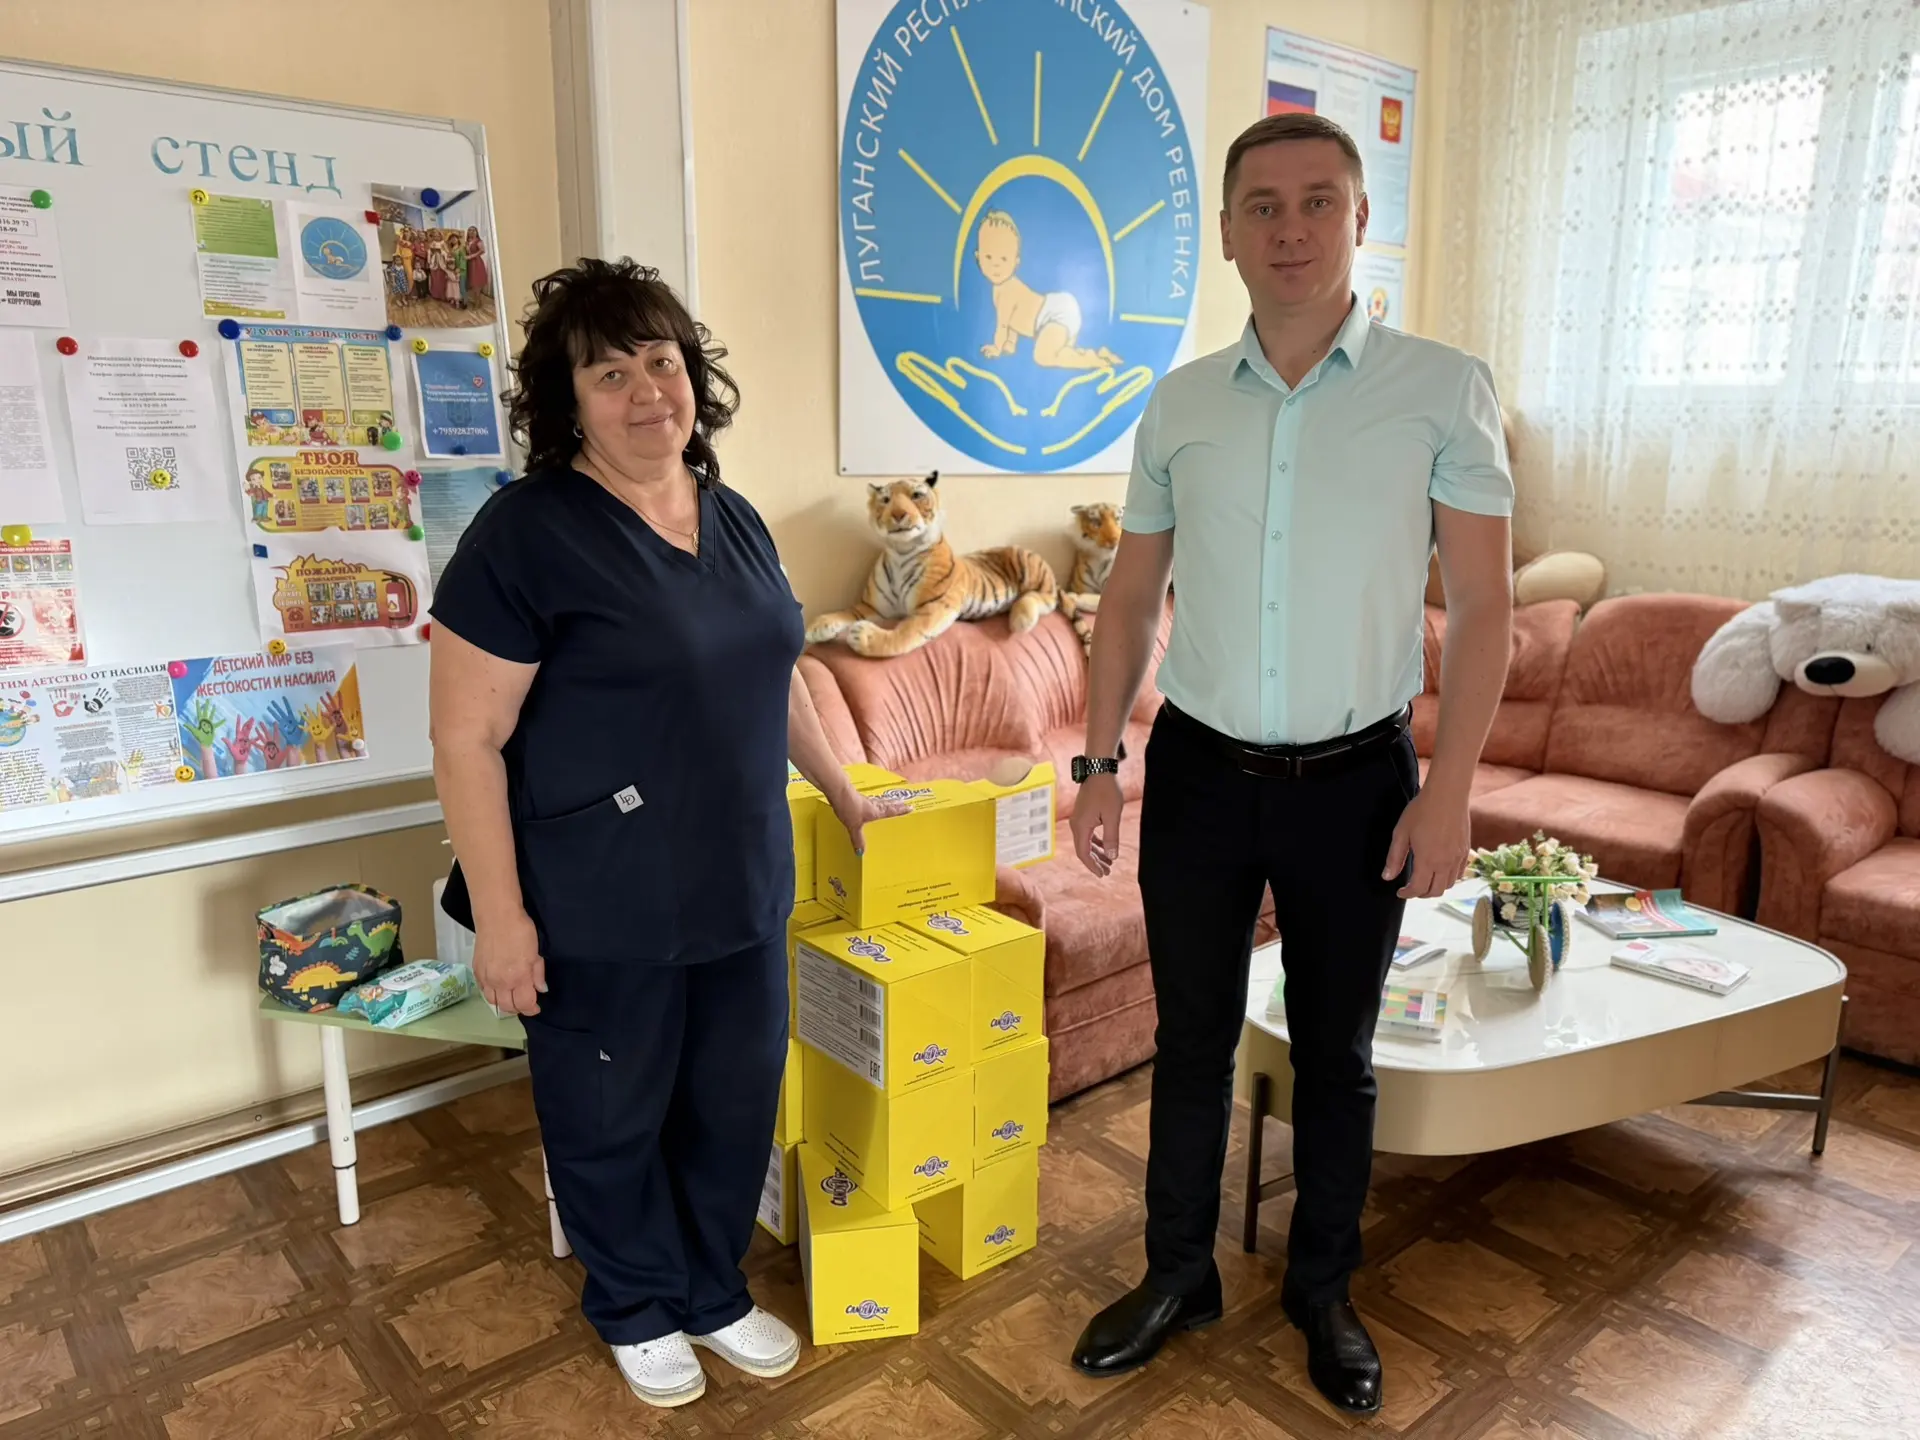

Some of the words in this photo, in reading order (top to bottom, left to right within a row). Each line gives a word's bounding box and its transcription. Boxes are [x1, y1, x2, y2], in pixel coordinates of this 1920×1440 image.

[151, 136, 342, 199] стенд
[852, 48, 903, 283] ЛУГАНСКИЙ
[1132, 67, 1176, 138] ДОМ
[1166, 146, 1192, 298] РЕБЕНКА
[6, 289, 17, 297] МЫ
[18, 290, 40, 298] ПРОТИВ
[7, 298, 41, 306] КОРРУПЦИИ
[245, 327, 290, 337] УГОЛОК
[294, 329, 378, 341] БЕЗОПАСНОСТИ
[300, 452, 357, 466] ТВОЯ
[294, 468, 365, 476] БЕЗОПАСНОСТЬ
[296, 566, 362, 577] ПОЖАРНАЯ
[213, 652, 265, 676] ДЕТСКИЙ
[268, 653, 292, 668] МИР
[295, 651, 314, 664] БЕЗ
[31, 673, 88, 688] ДЕТСТВО
[91, 671, 107, 680] ОТ
[110, 663, 167, 678] НАСИЛИЯ
[197, 676, 271, 697] ЖЕСТОКОСТИ
[274, 677, 282, 688] И
[285, 670, 336, 687] НАСИЛИЯ
